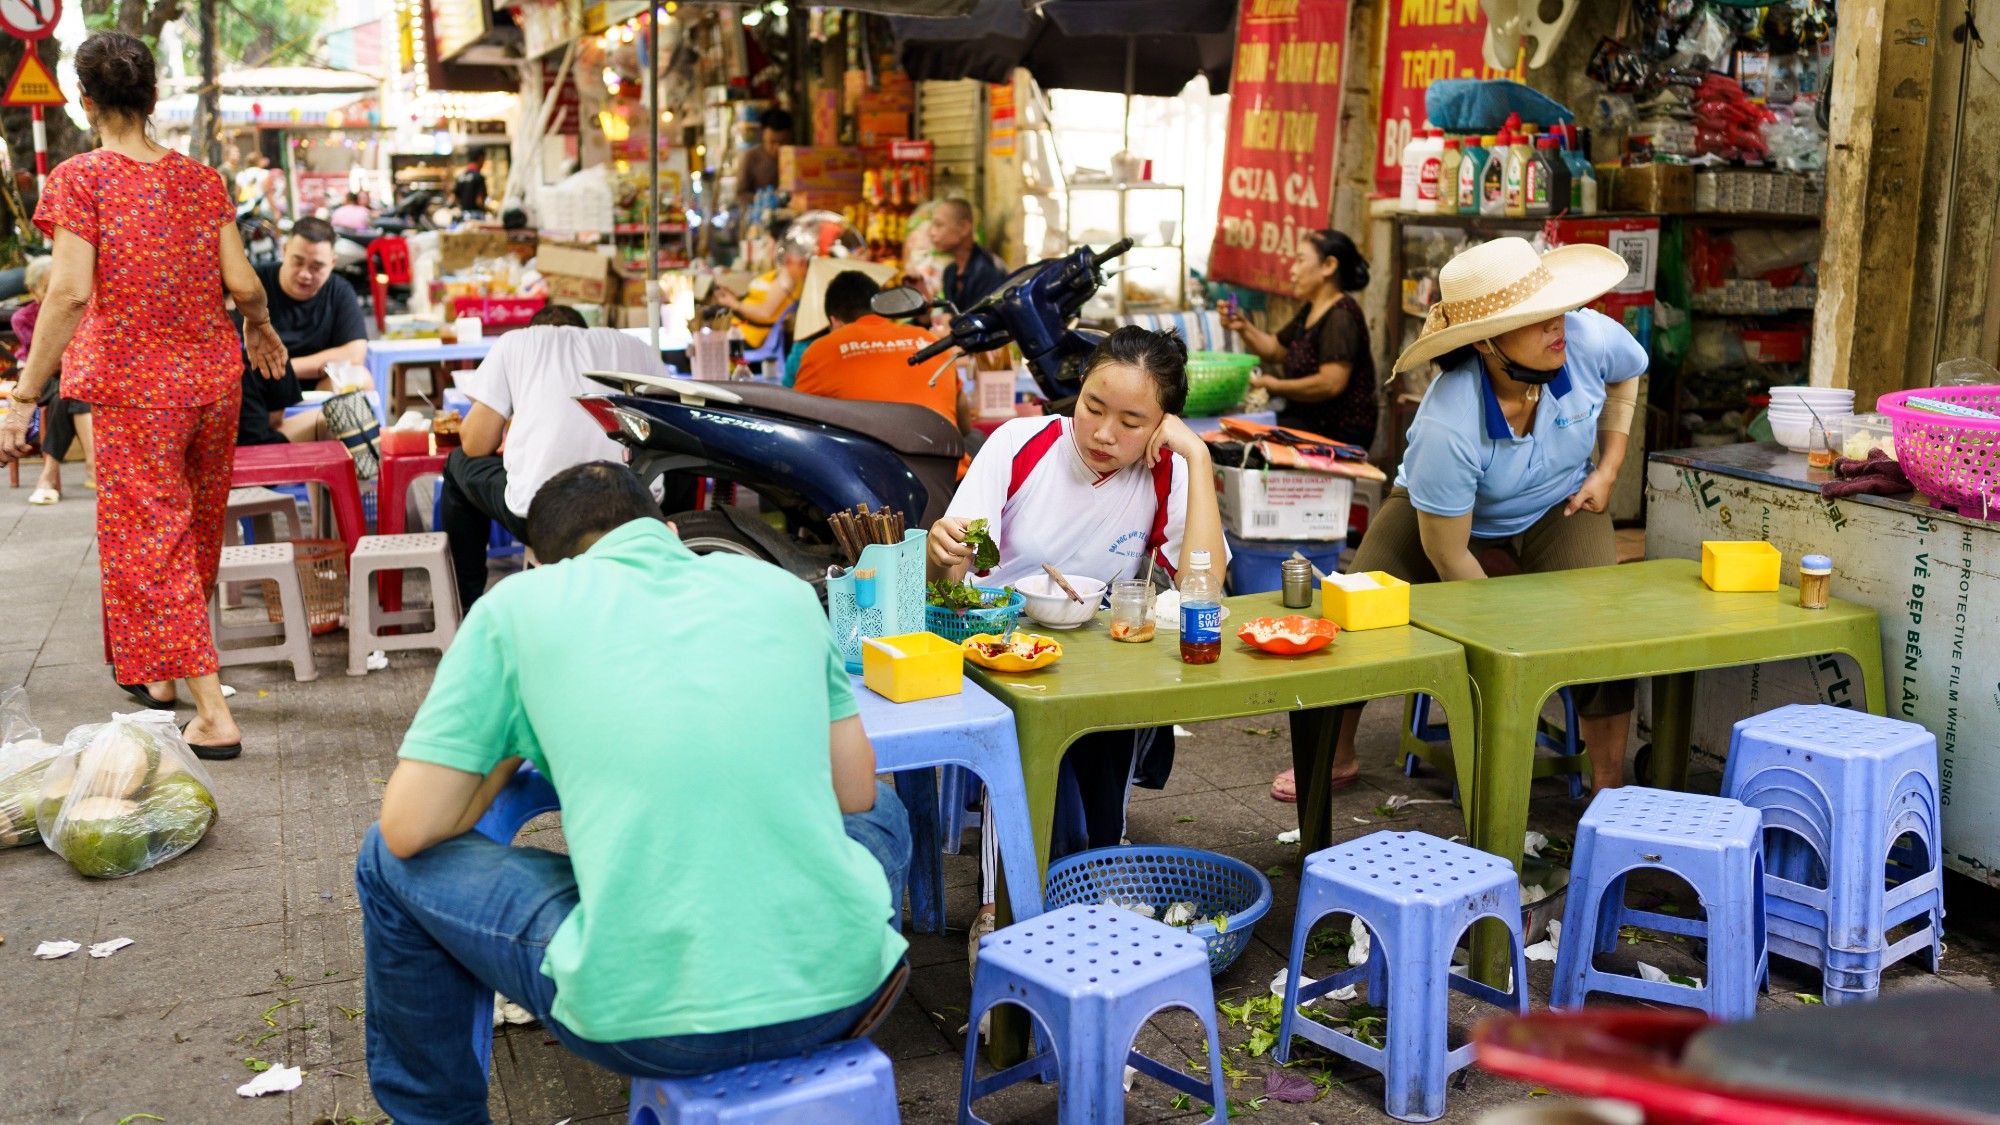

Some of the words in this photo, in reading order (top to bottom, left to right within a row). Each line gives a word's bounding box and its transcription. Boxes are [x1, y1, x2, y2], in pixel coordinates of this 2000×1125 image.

[1228, 166, 1280, 202] CUA
[689, 409, 776, 433] VISION
[1962, 528, 1972, 552] HE
[1914, 552, 1931, 579] VẺ
[1905, 584, 1925, 625] ĐẸP
[1951, 558, 1972, 660] PROTECTIVE
[1904, 629, 1923, 672] BỀN
[1750, 663, 1760, 703] PANEL
[1901, 676, 1919, 718] LÂU
[1948, 665, 1961, 702] FILM
[1944, 707, 1957, 753] WHEN
[1941, 758, 1953, 806] USING
